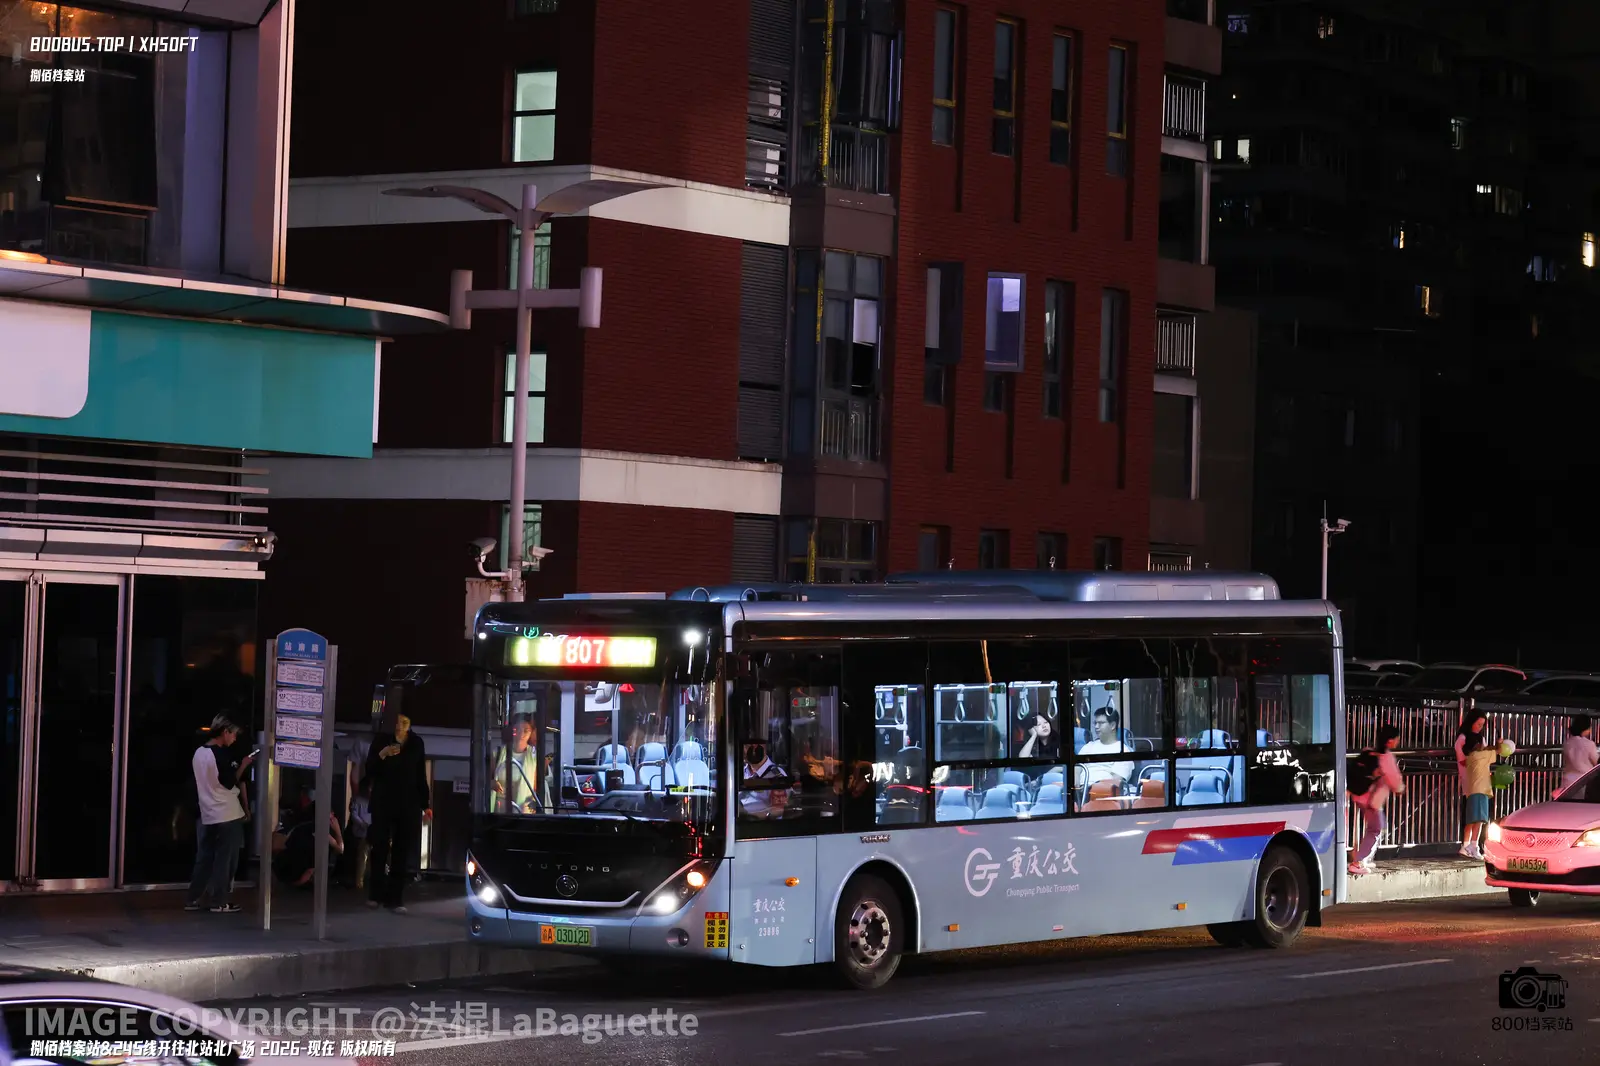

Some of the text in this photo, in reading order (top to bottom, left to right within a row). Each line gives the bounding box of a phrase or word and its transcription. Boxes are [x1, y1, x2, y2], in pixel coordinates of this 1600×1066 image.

[565, 639, 606, 665] 807
[527, 863, 610, 873] YUTONG
[1006, 842, 1080, 880] 重庆公交
[1036, 885, 1053, 894] Public
[1053, 883, 1080, 894] Transport
[752, 897, 786, 914] 重庆公交
